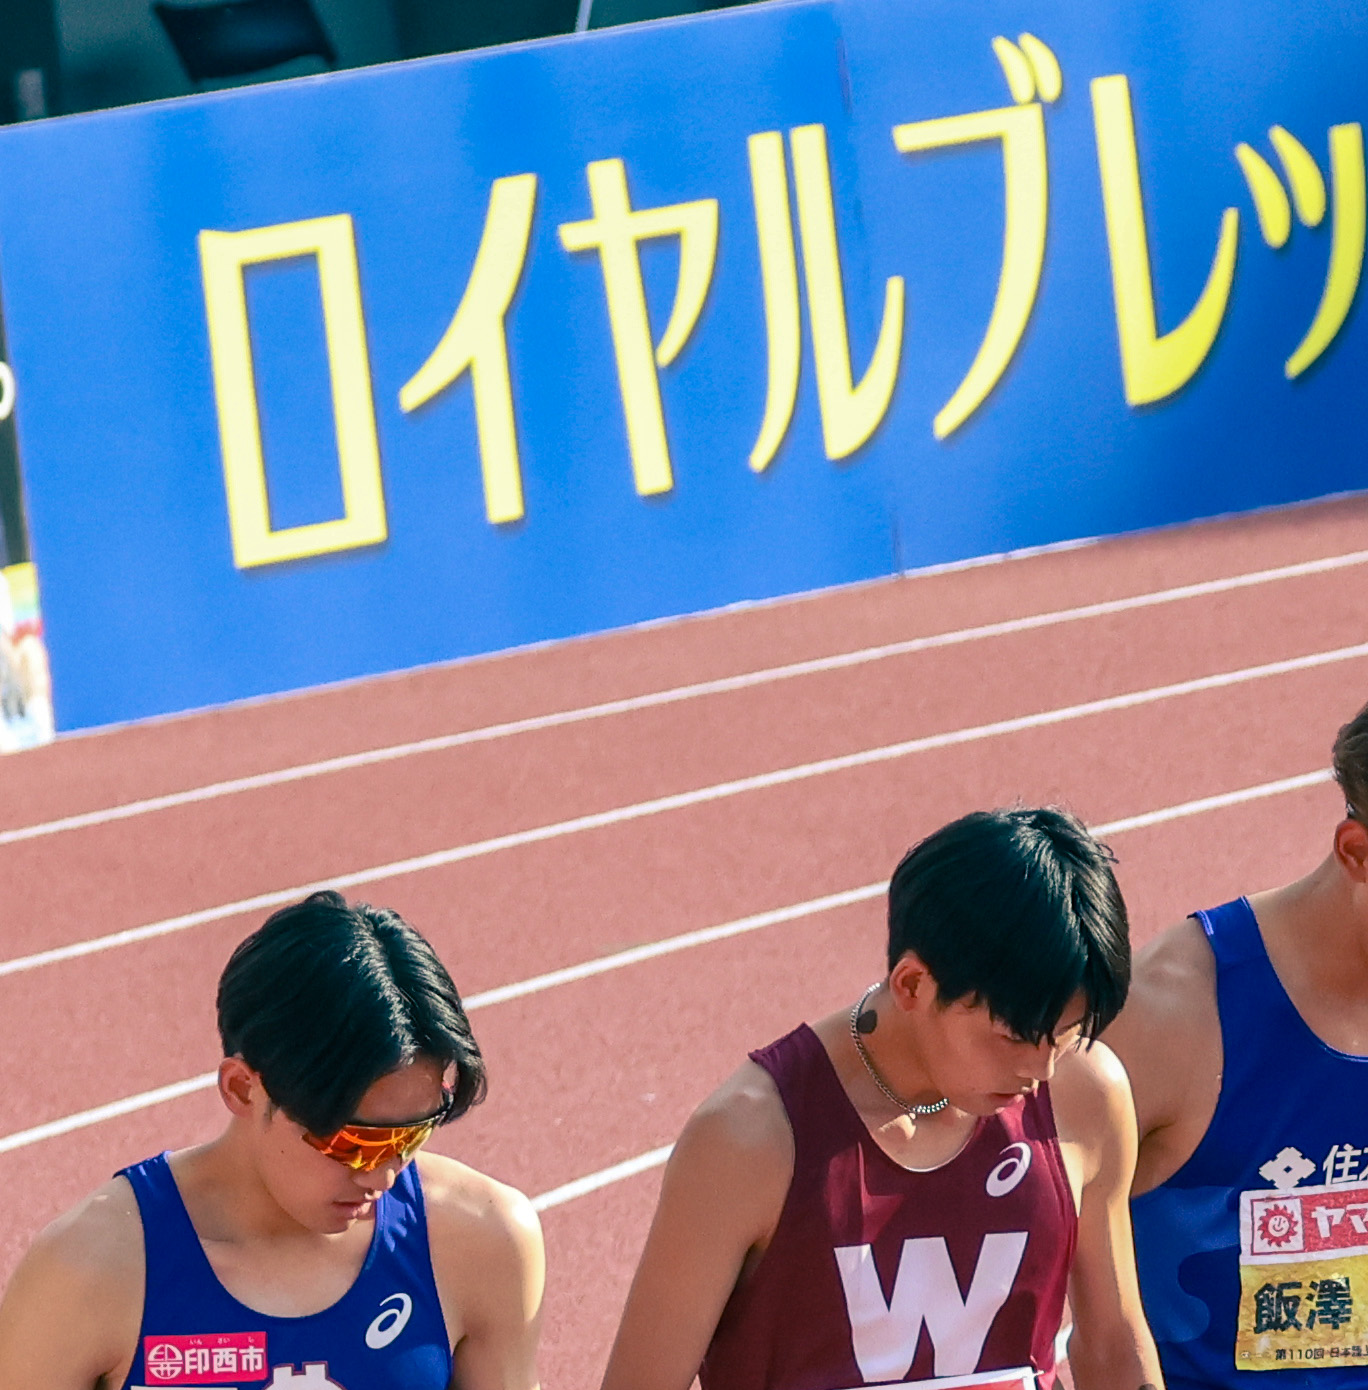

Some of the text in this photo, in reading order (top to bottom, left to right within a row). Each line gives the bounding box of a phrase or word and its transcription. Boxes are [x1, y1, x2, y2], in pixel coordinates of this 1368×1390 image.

[832, 1230, 1030, 1384] W
[1253, 1275, 1354, 1336] 飯澤
[184, 1345, 265, 1375] 印西市
[1274, 1346, 1325, 1361] 第110回
